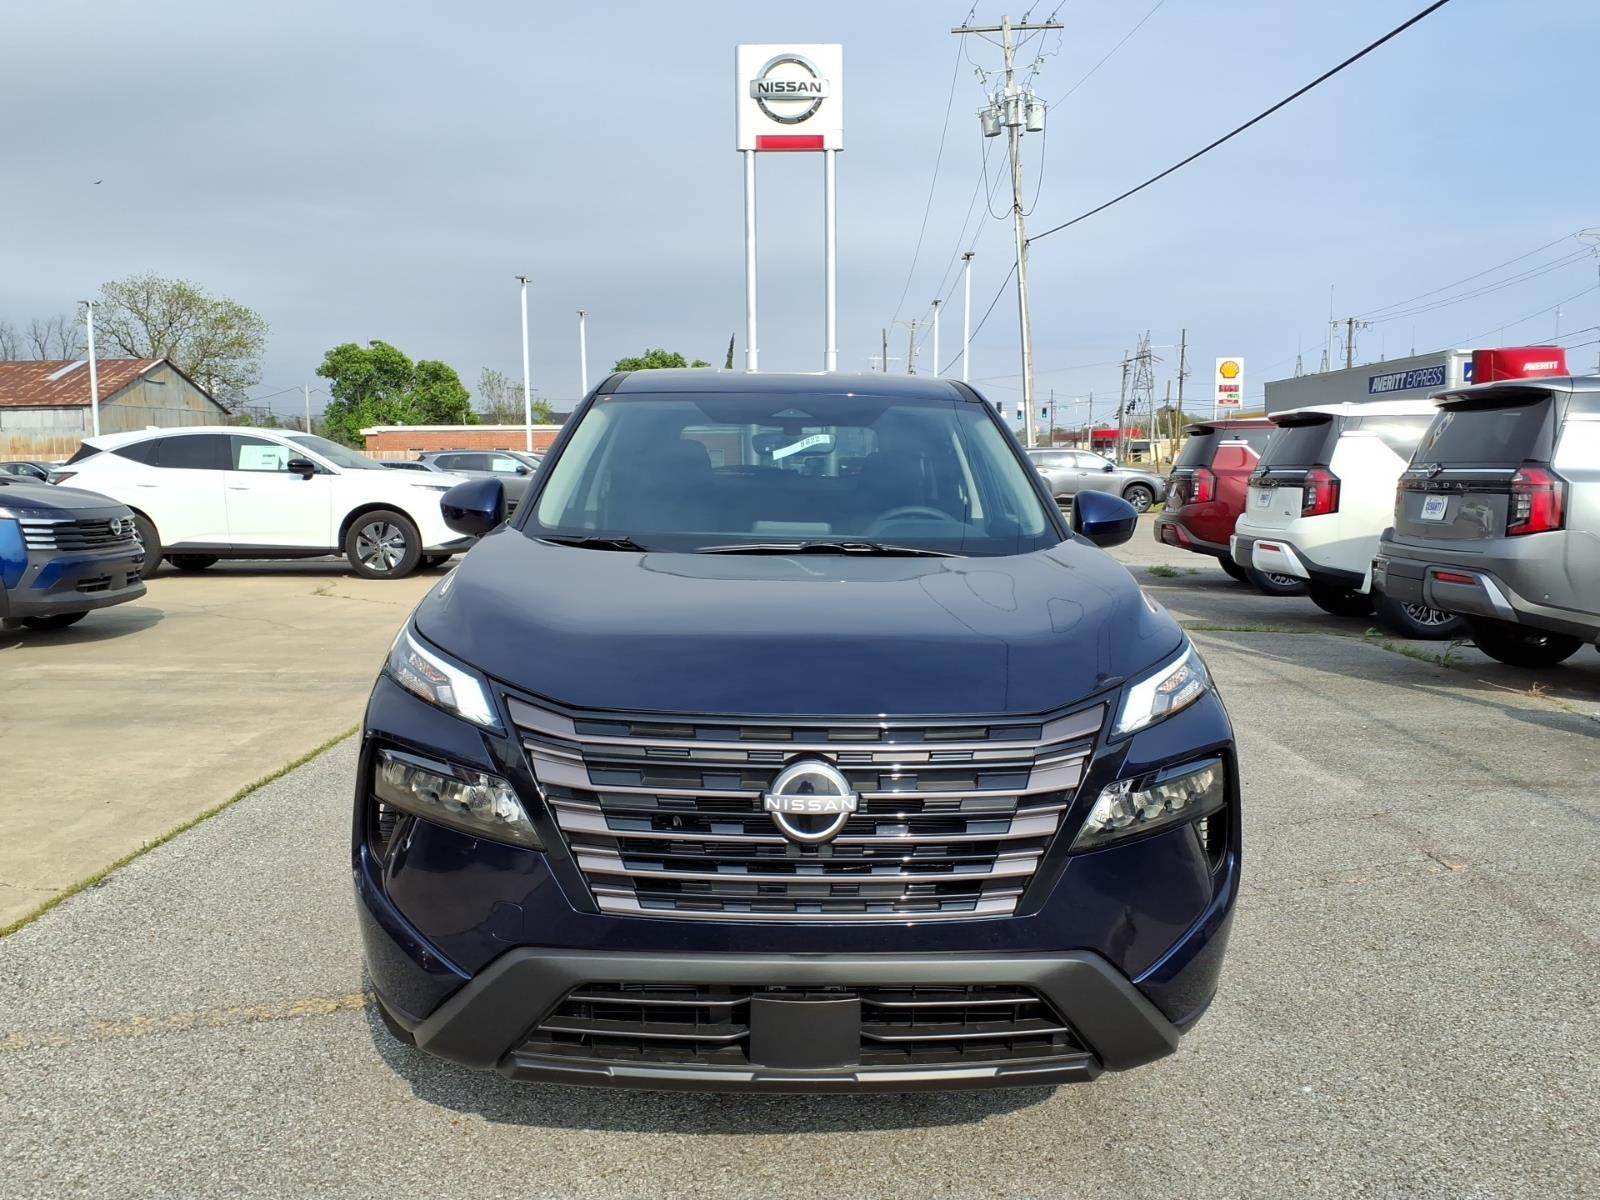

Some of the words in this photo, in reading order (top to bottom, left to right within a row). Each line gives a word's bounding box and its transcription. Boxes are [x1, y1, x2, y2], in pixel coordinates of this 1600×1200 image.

[758, 81, 822, 93] NISSAN
[1522, 360, 1559, 371] AVERITT
[1371, 372, 1407, 393] AVERITT
[1406, 367, 1444, 388] EXPRESS
[766, 797, 855, 812] NISSAN
